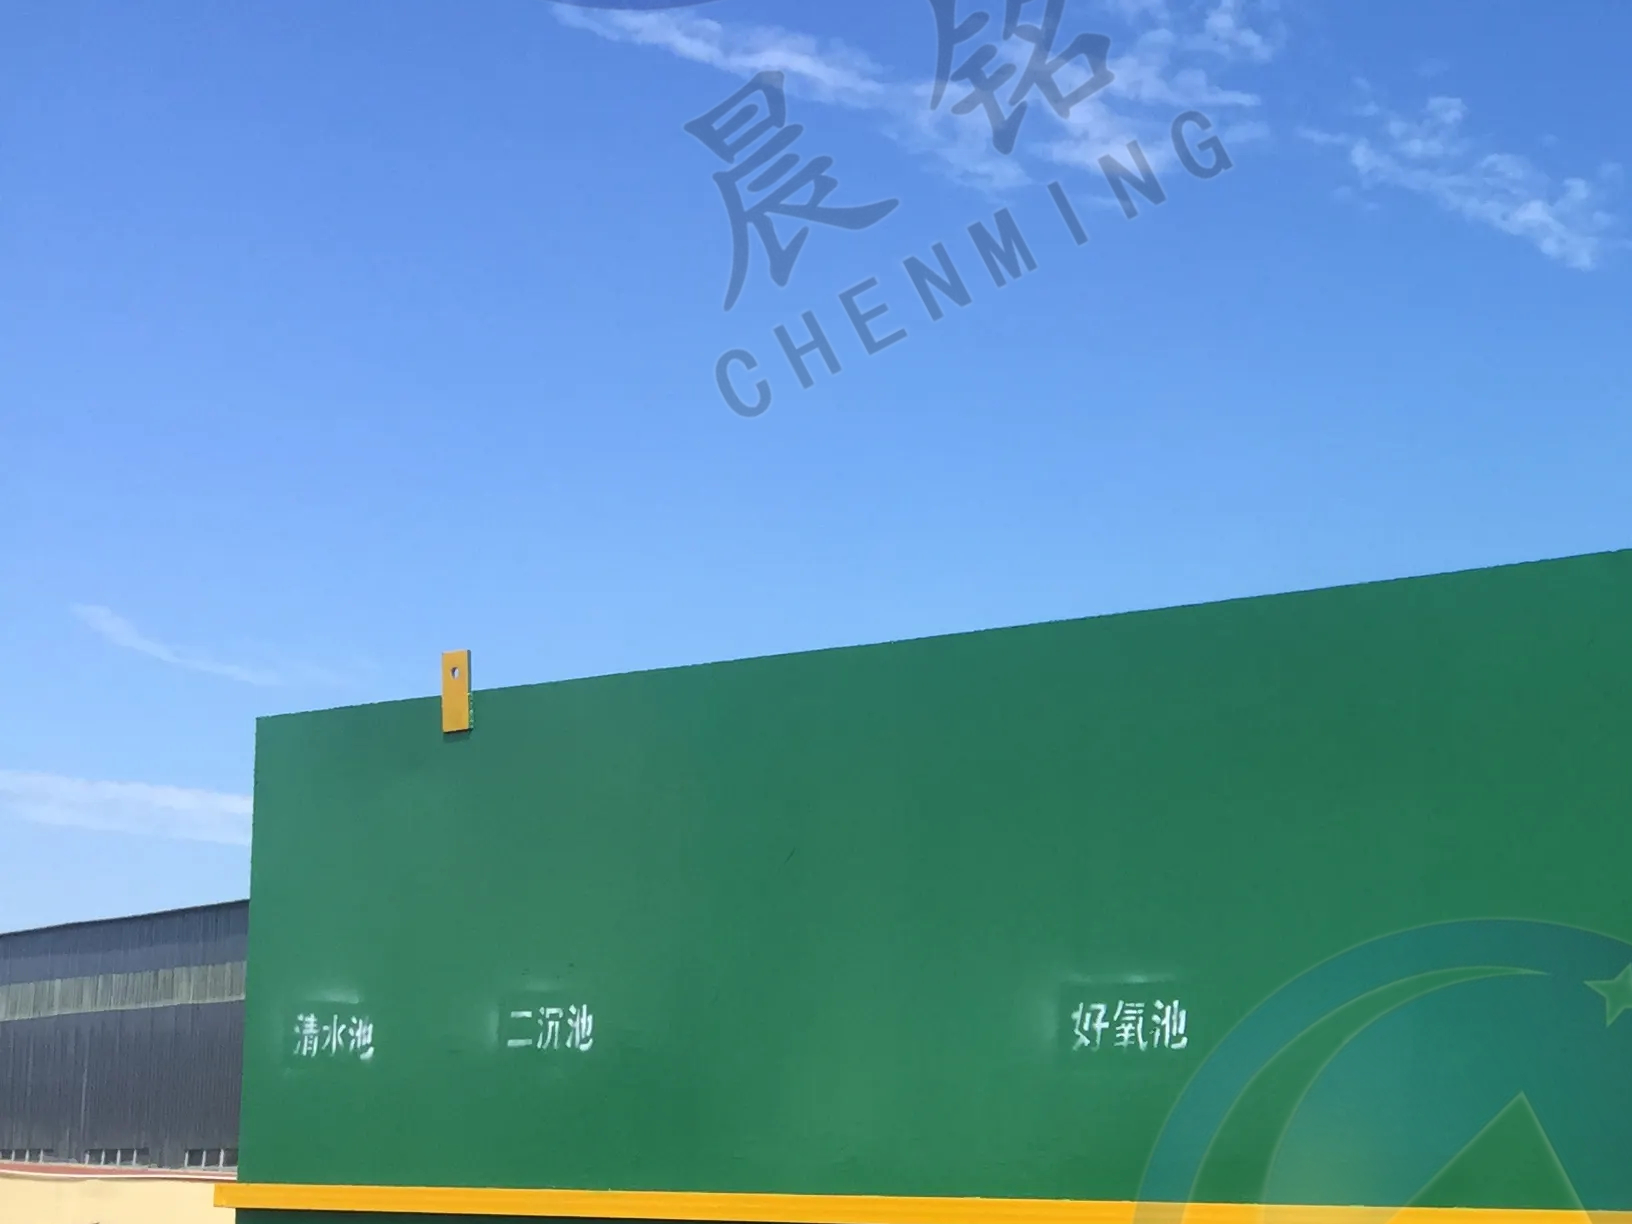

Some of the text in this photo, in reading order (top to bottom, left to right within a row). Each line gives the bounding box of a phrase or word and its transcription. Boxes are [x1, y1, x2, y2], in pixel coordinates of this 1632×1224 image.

[292, 1012, 375, 1061] 清水池
[507, 1003, 594, 1052] 二沉池
[1070, 1000, 1189, 1051] 好氧池
